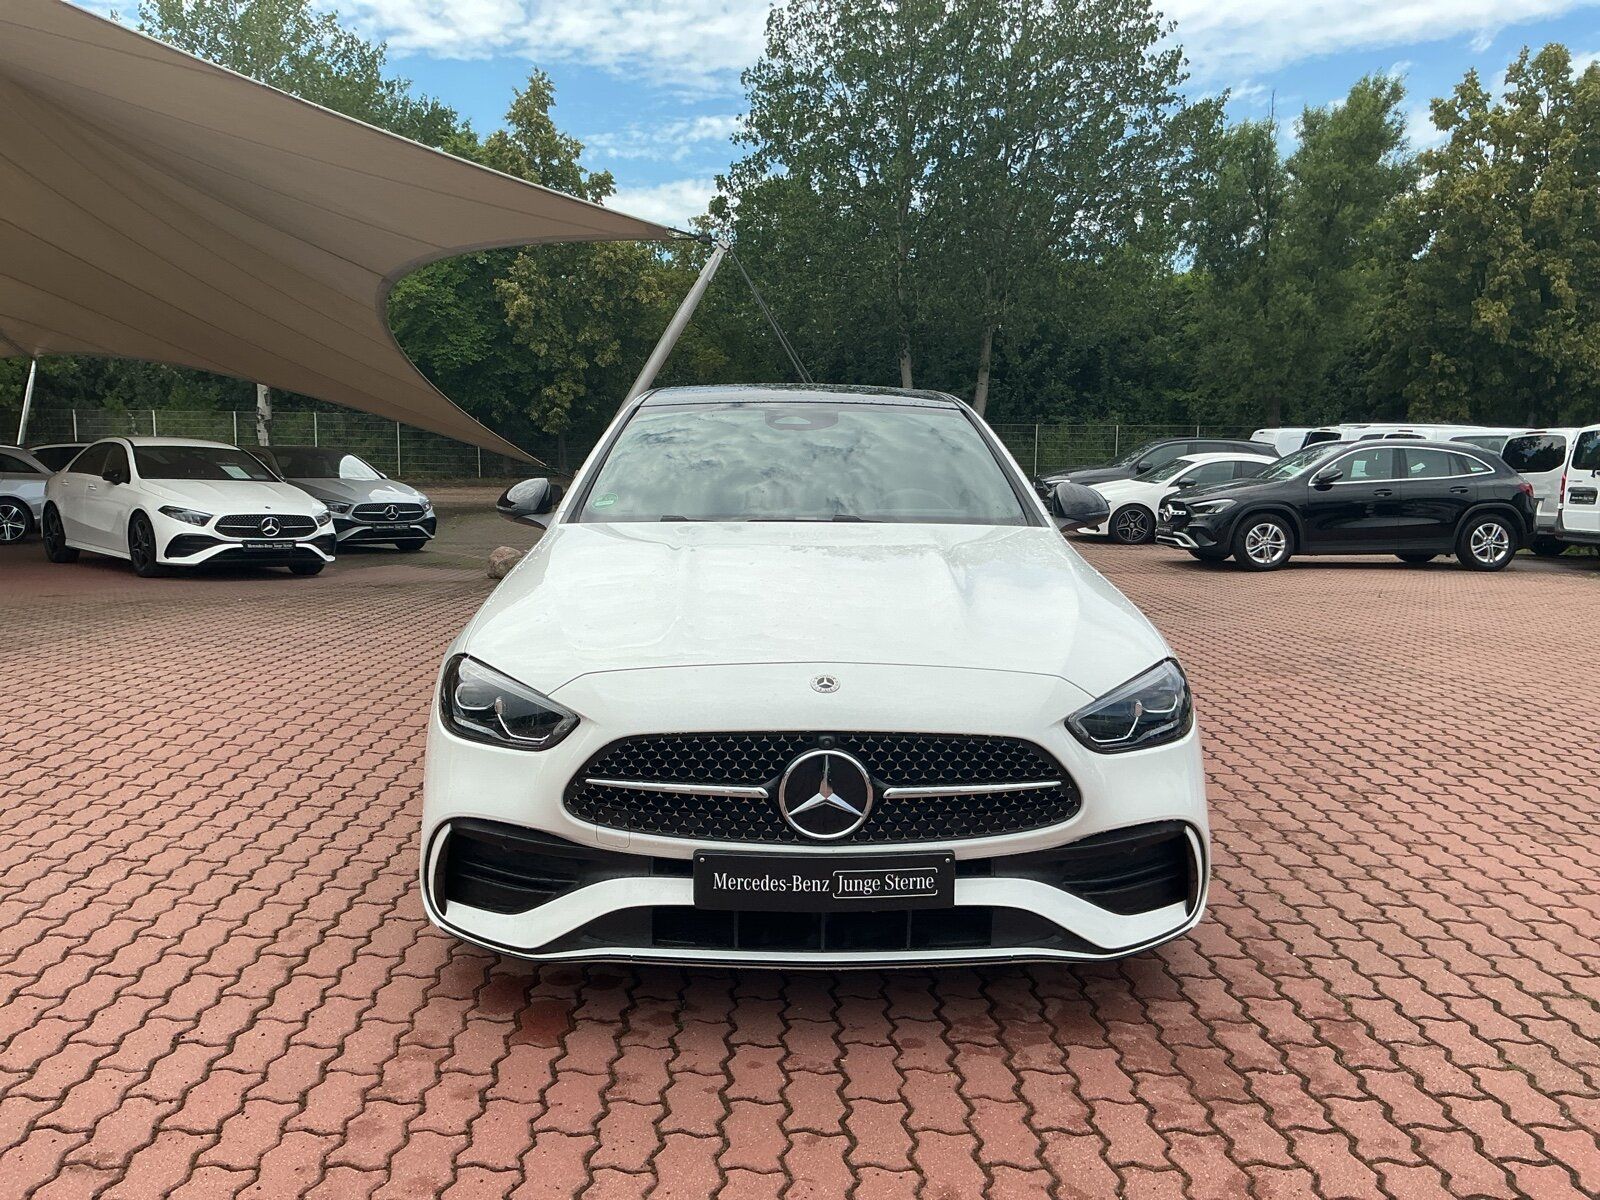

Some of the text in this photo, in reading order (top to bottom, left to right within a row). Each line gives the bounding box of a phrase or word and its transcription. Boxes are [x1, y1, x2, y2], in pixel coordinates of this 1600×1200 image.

[713, 872, 934, 894] Mercedes-Benz Junge Sterne
